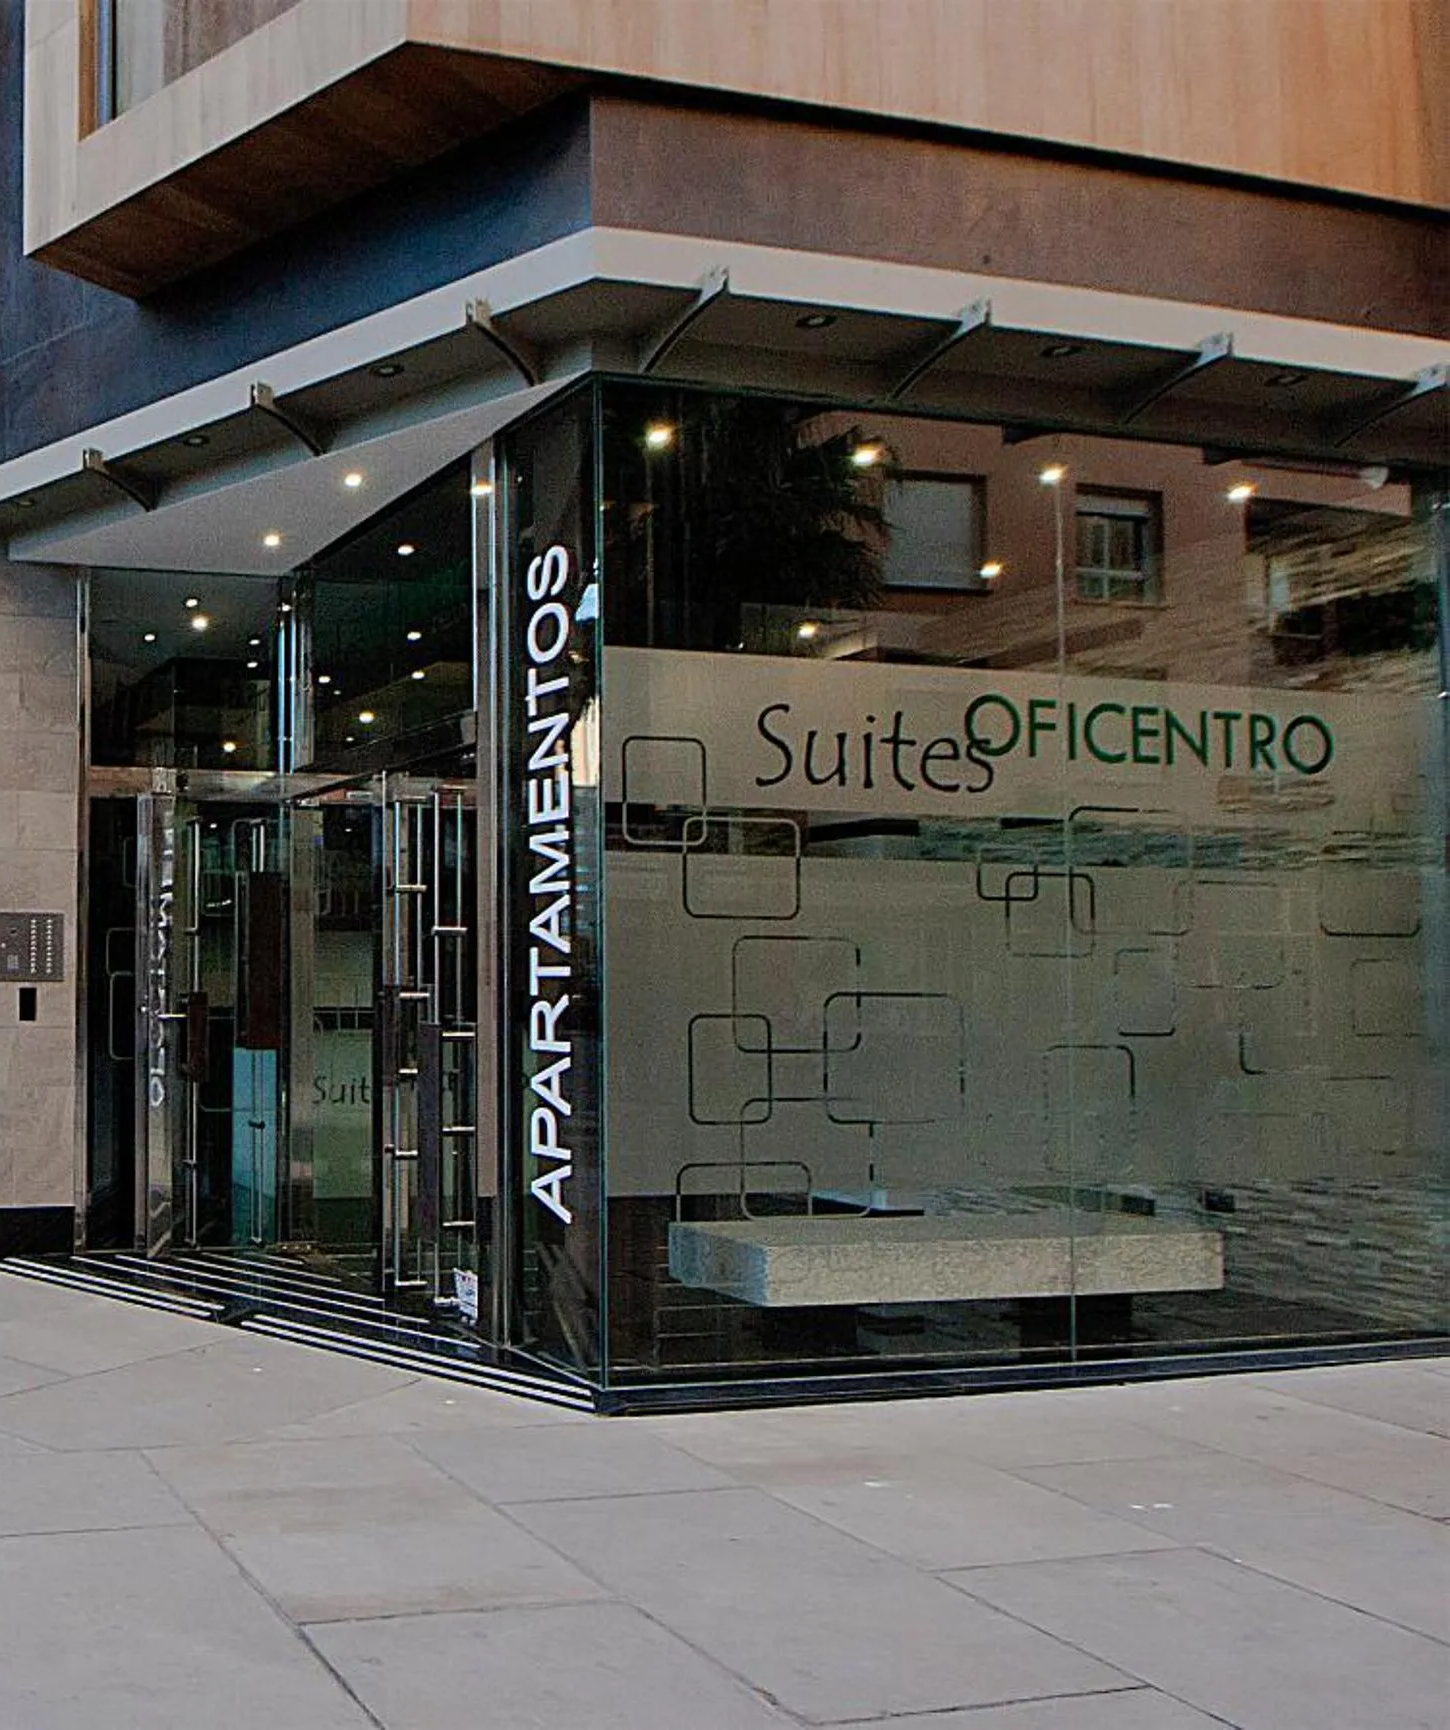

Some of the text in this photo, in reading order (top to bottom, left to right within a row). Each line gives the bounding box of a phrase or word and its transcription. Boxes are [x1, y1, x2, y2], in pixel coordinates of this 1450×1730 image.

[525, 543, 572, 1225] APARTAMENTOS
[755, 692, 1335, 793] Suites OFICENTRO
